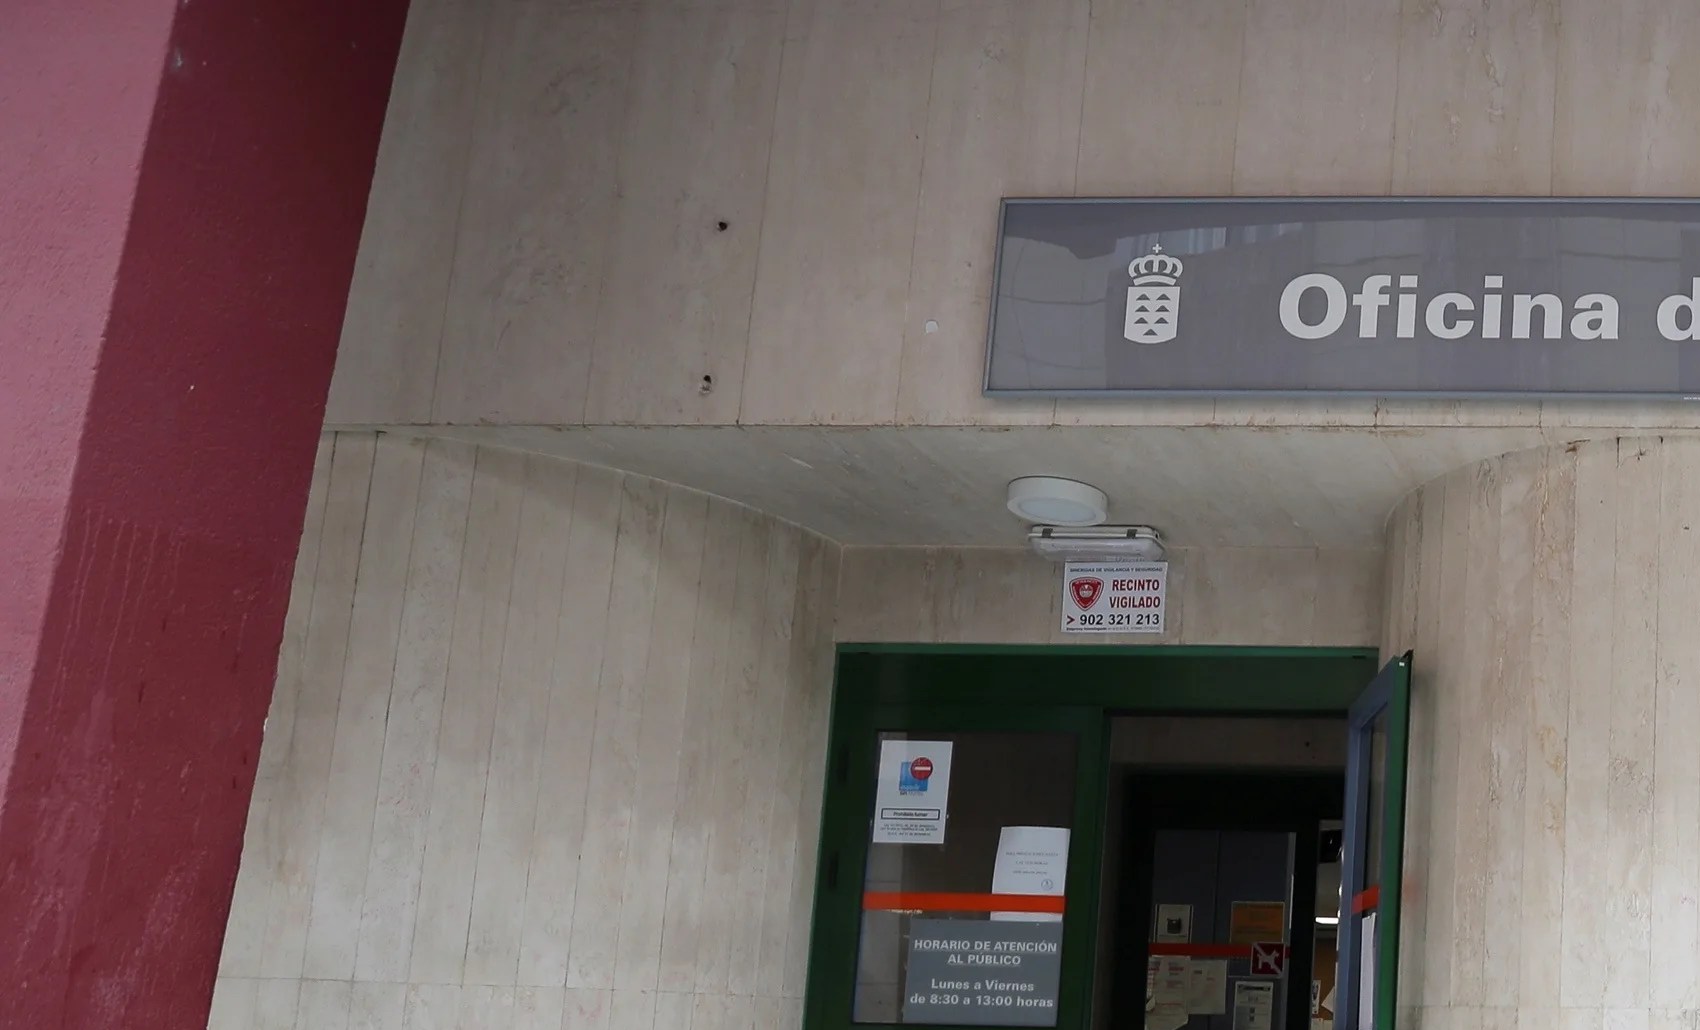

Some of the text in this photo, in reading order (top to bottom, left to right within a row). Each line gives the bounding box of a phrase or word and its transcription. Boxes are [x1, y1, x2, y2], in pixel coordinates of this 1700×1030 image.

[1279, 273, 1619, 339] Oficina
[1112, 579, 1160, 591] RECINTO
[1109, 596, 1161, 608] VIGILADO
[1079, 613, 1160, 625] 902 321 213
[914, 939, 1057, 952] HORARIO DE ATENCIÓN
[947, 952, 1021, 965] AL PÚBLICO
[931, 978, 1034, 992] Lunes a Viernes
[910, 993, 1054, 1007] de 8:30 a 13:00 horas
